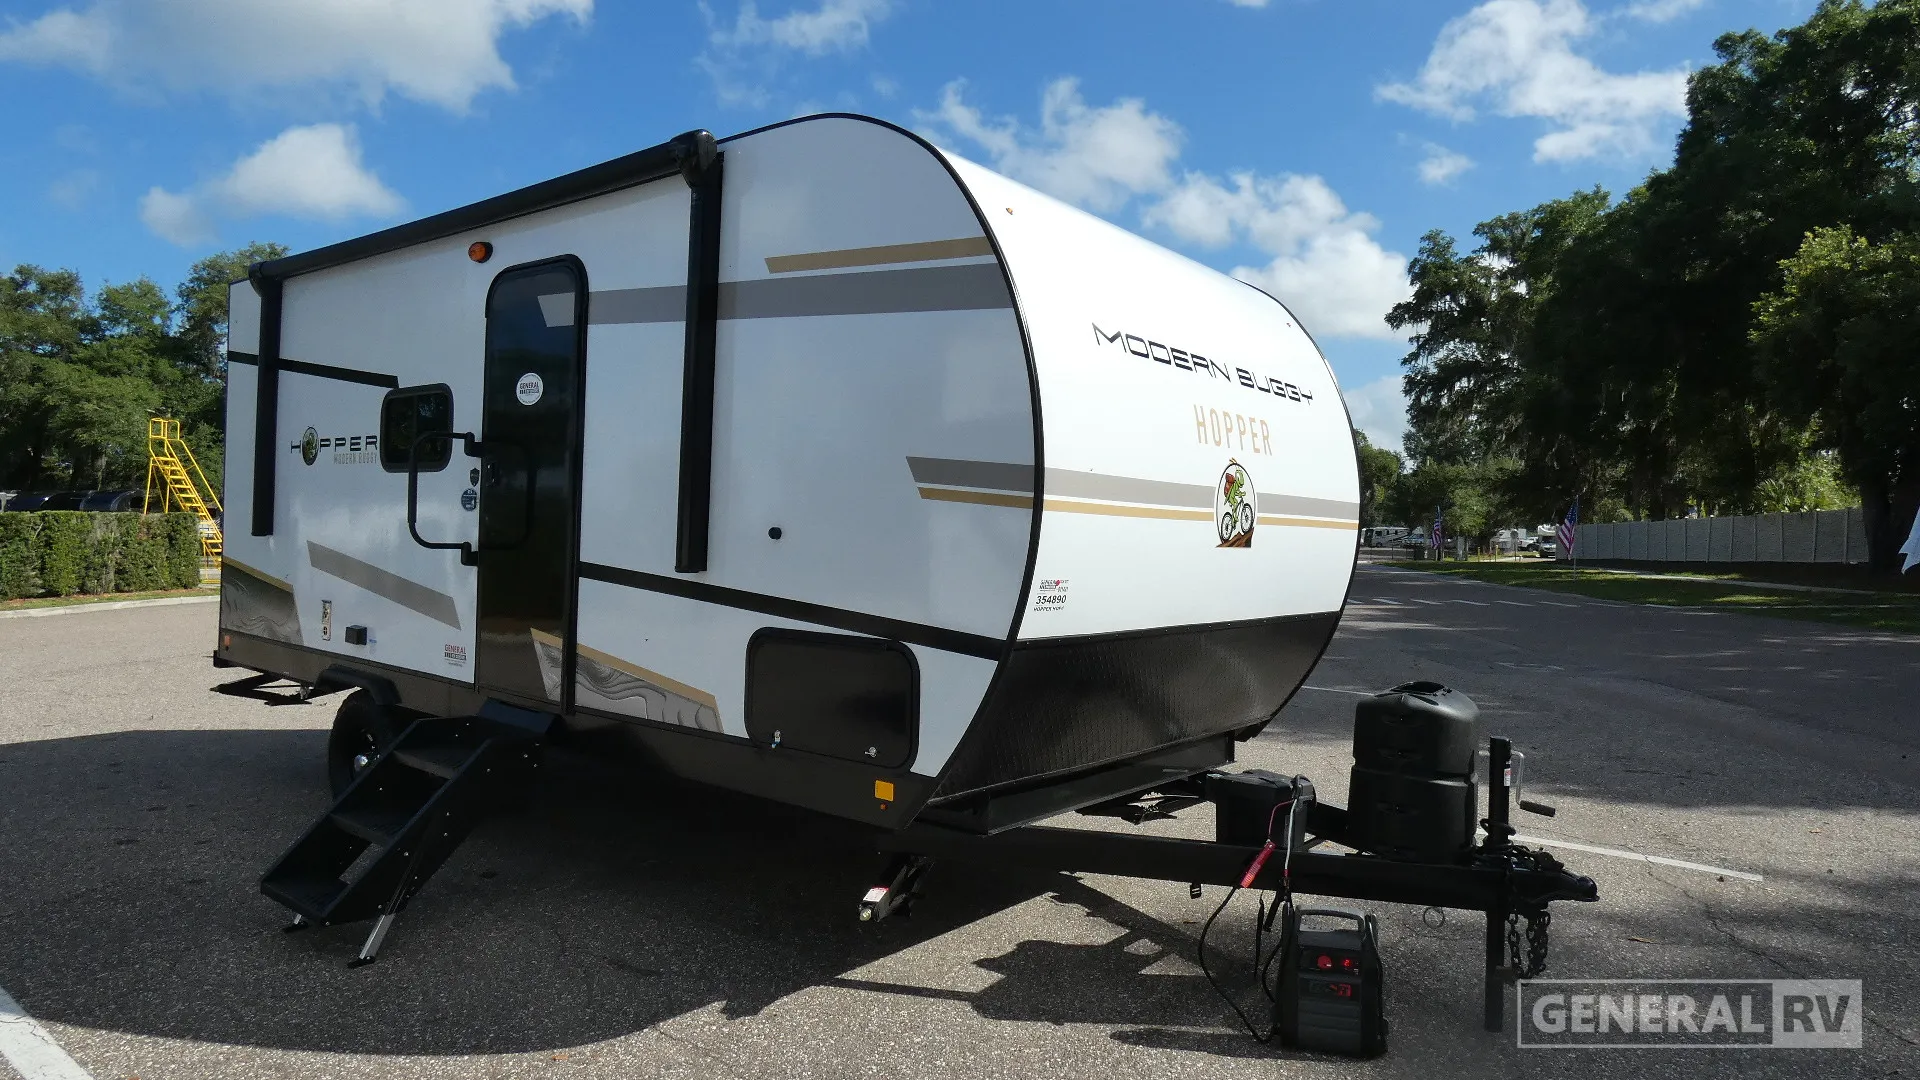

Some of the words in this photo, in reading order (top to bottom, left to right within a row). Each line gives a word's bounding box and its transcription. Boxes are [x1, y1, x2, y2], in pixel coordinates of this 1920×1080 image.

[1092, 322, 1231, 382] MODERN
[1236, 367, 1313, 405] BUGGY
[1194, 404, 1273, 456] HOPPER
[334, 453, 356, 465] MODERN
[1036, 595, 1067, 605] 354890
[444, 643, 467, 655] GENERAL
